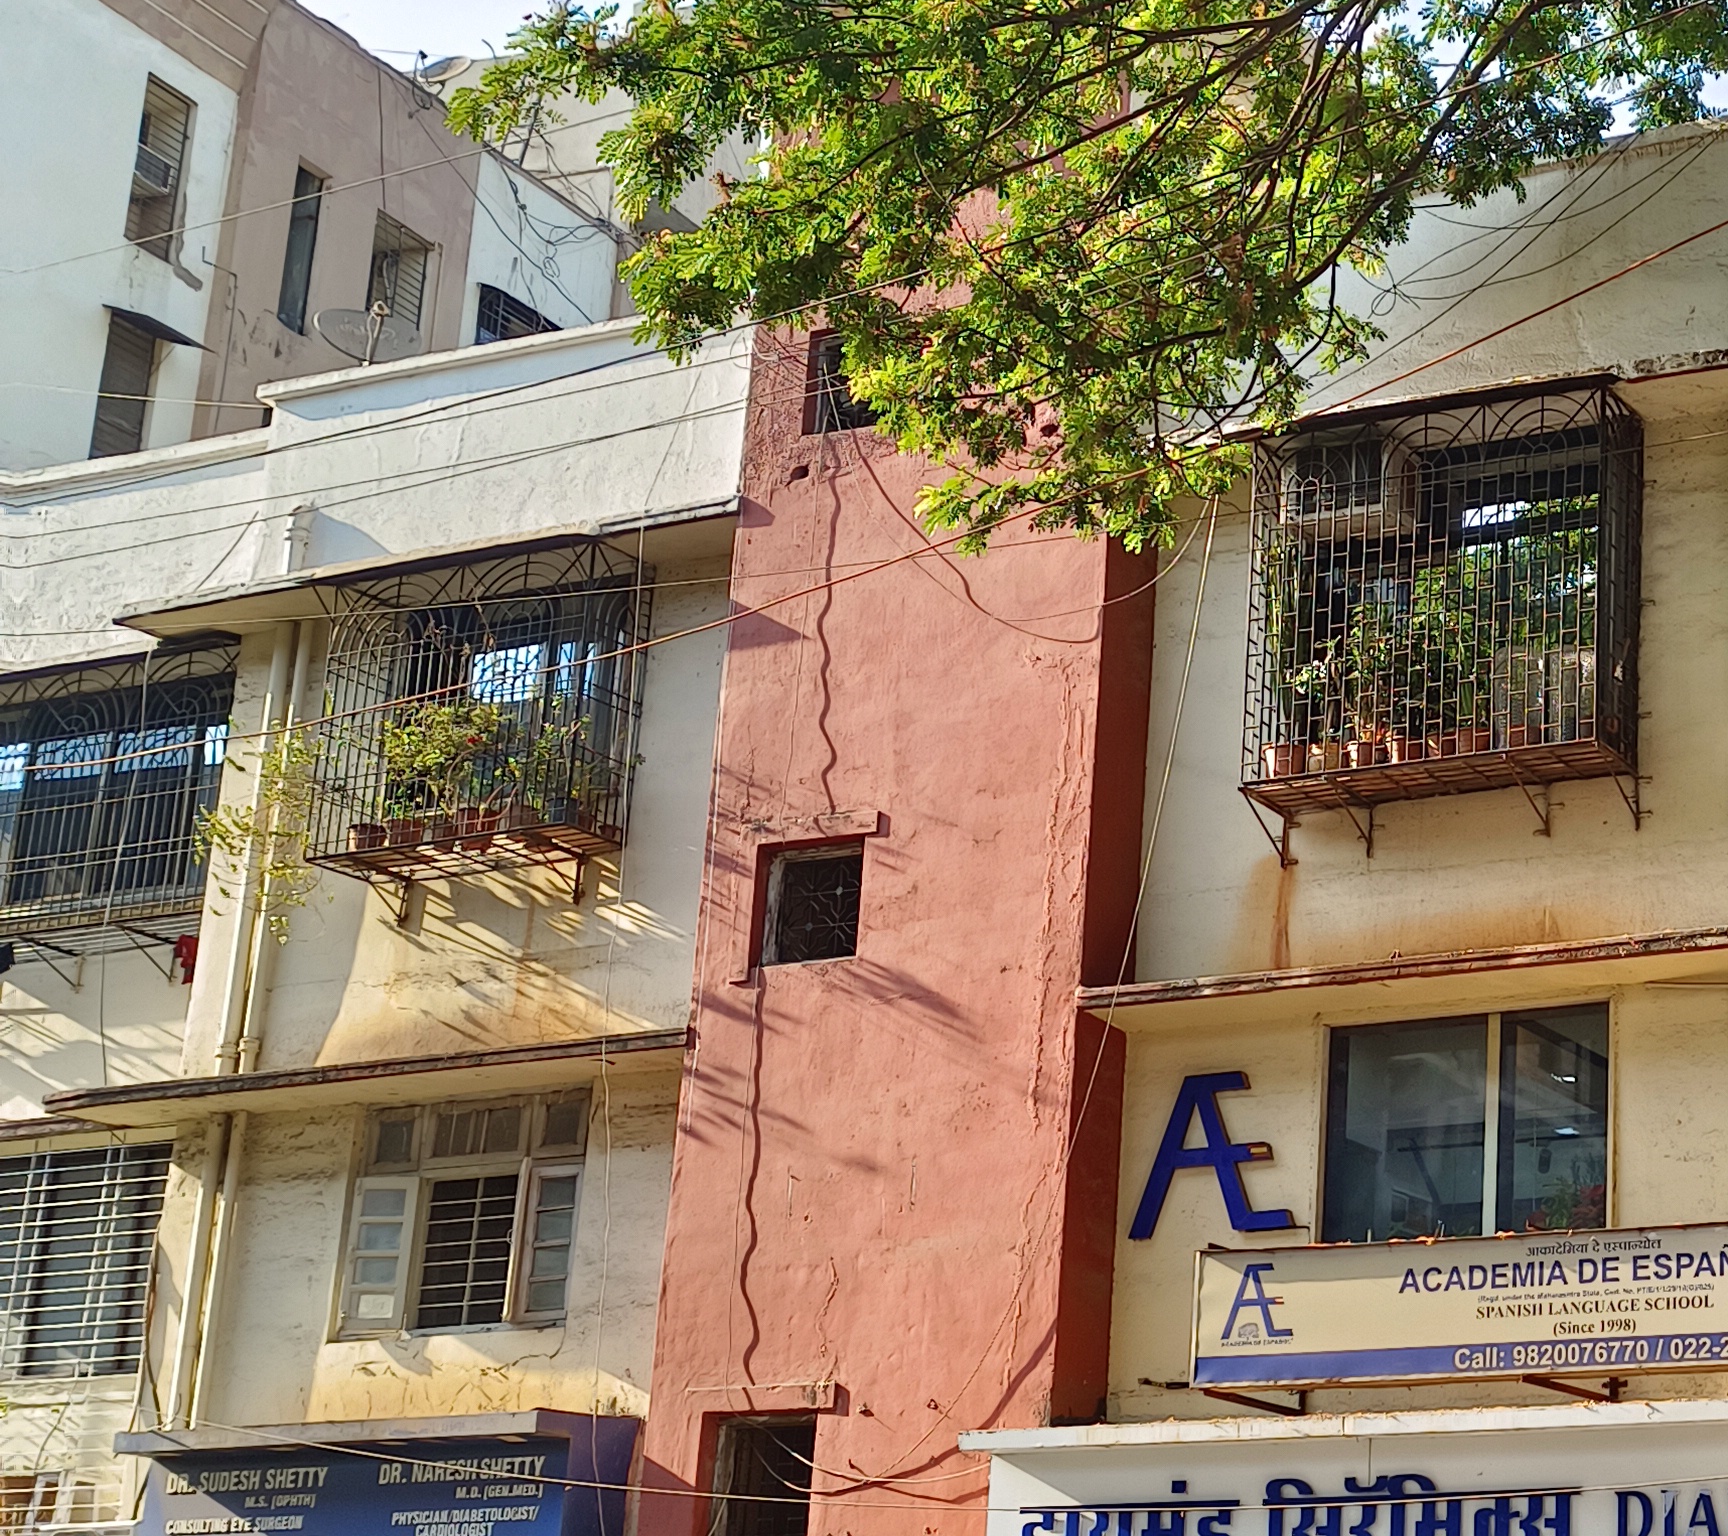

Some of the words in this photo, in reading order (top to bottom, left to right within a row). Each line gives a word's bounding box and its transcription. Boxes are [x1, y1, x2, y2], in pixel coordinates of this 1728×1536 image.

[1399, 1259, 1568, 1294] ACADEMIA
[1578, 1256, 1621, 1284] DE
[1476, 1302, 1543, 1320] SPANISH
[1548, 1298, 1641, 1316] LANGUAGE
[1644, 1295, 1714, 1311] SCHOOL
[1553, 1321, 1595, 1337] (Since
[1600, 1318, 1637, 1334] 1998)
[1454, 1347, 1505, 1369] Call:
[1512, 1339, 1649, 1367] 9820076770
[200, 1469, 262, 1493] SUDESH
[265, 1466, 328, 1490] SHETTY
[378, 1463, 407, 1485] DR.
